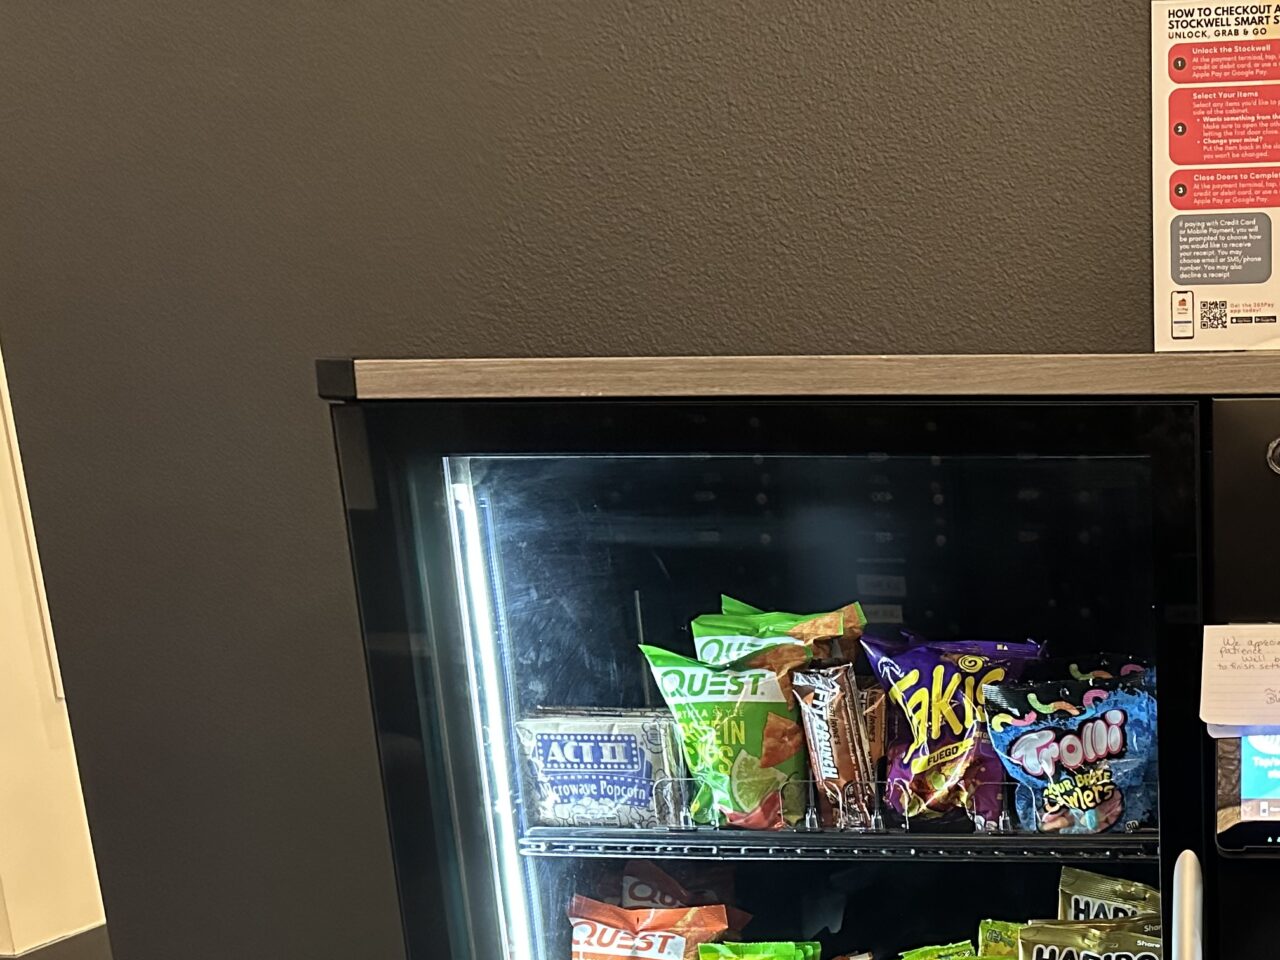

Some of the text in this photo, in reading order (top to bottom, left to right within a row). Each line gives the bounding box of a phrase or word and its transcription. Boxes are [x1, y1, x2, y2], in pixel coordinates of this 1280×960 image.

[1168, 9, 1194, 18] HOW
[1198, 8, 1212, 17] TO
[1214, 5, 1271, 16] CHECKOUT
[1168, 18, 1231, 29] STOCKWELL
[1234, 15, 1269, 27] SMART
[1168, 30, 1210, 39] UNLOCK,
[1214, 29, 1239, 37] GRAB
[1192, 47, 1218, 55] Unlock
[1233, 44, 1271, 53] Stockwell
[1193, 92, 1216, 100] Select
[1185, 220, 1205, 229] paying
[1188, 234, 1217, 243] prompted
[1223, 636, 1240, 646] We
[1220, 646, 1263, 658] patience
[661, 669, 767, 698] QUEST
[812, 689, 838, 780] FIT CRUNCH
[1010, 708, 1128, 776] Trolli
[547, 741, 628, 763] ACT II
[928, 745, 960, 766] FUEGO
[540, 780, 646, 802] Microwave Popcorn
[572, 921, 676, 954] QUEST
